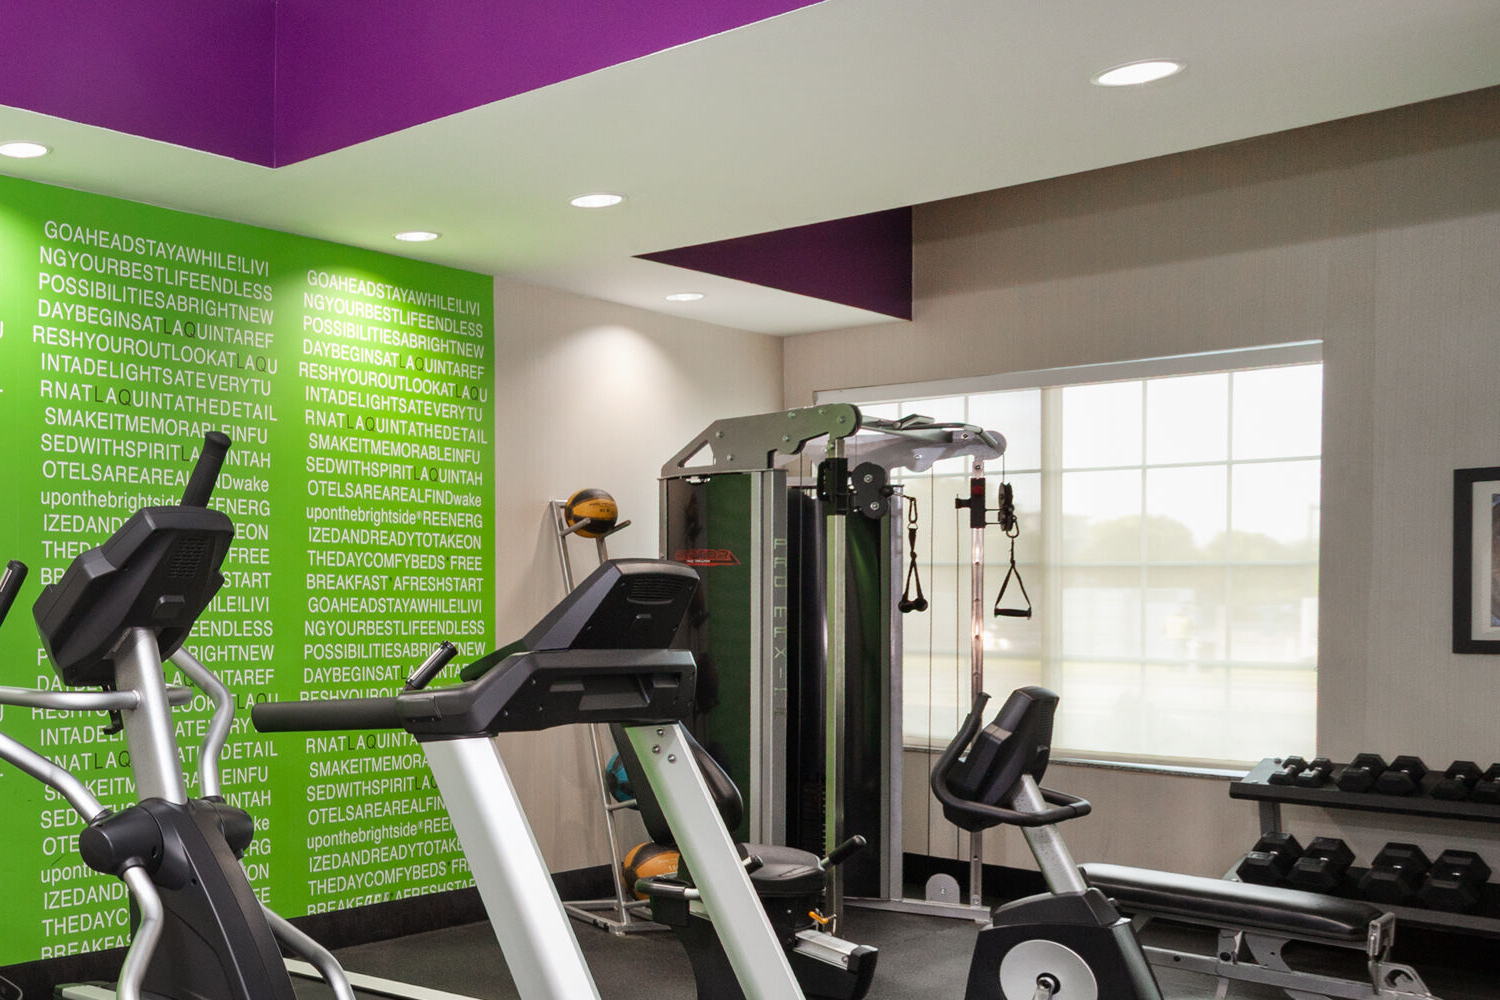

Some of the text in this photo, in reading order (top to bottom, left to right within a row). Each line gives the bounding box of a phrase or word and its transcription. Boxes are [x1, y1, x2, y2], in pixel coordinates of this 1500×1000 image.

[39, 246, 273, 303] NGYOURBESTLIFEENDLESS
[43, 219, 269, 279] GOAHEADSTAYAWHILE!LIVI
[37, 299, 274, 351] DAYBEGINSATLAQUINTAREF
[38, 272, 274, 327] POSSIBILITIESABRIGHTNEW
[32, 326, 278, 376] RESHYOUROUTLOOKATLAQU
[40, 354, 271, 399] INTADELIGHTSATEVERYTU
[39, 380, 278, 424] RNATLAQUINTATHEDETAIL
